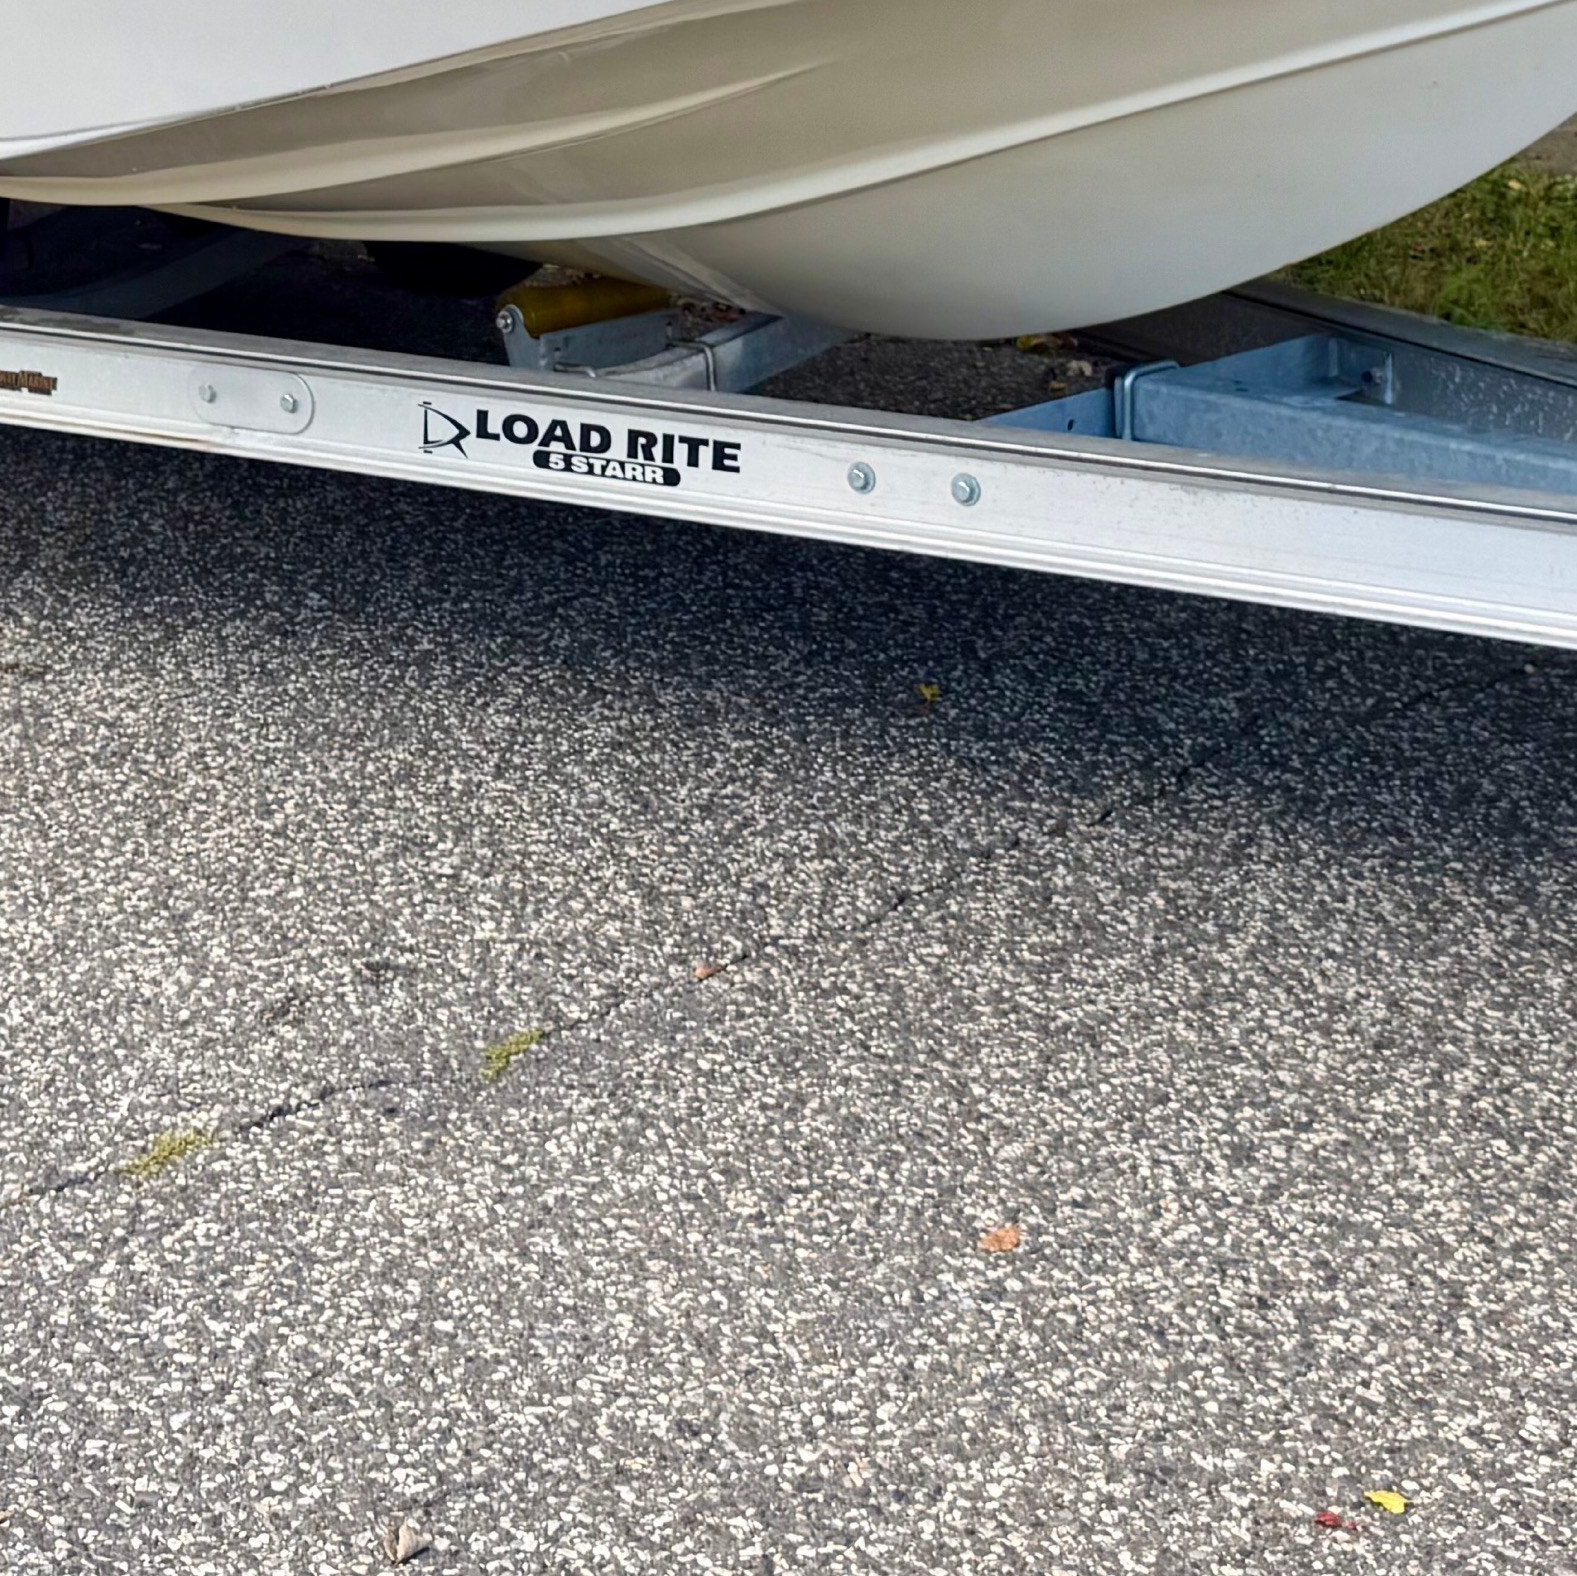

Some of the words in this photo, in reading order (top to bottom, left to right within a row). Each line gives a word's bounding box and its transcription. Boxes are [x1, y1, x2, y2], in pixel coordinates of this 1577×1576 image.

[475, 408, 612, 454] LOAD
[627, 427, 742, 474] RITE
[548, 451, 566, 471] 5
[570, 456, 665, 485] STARR
